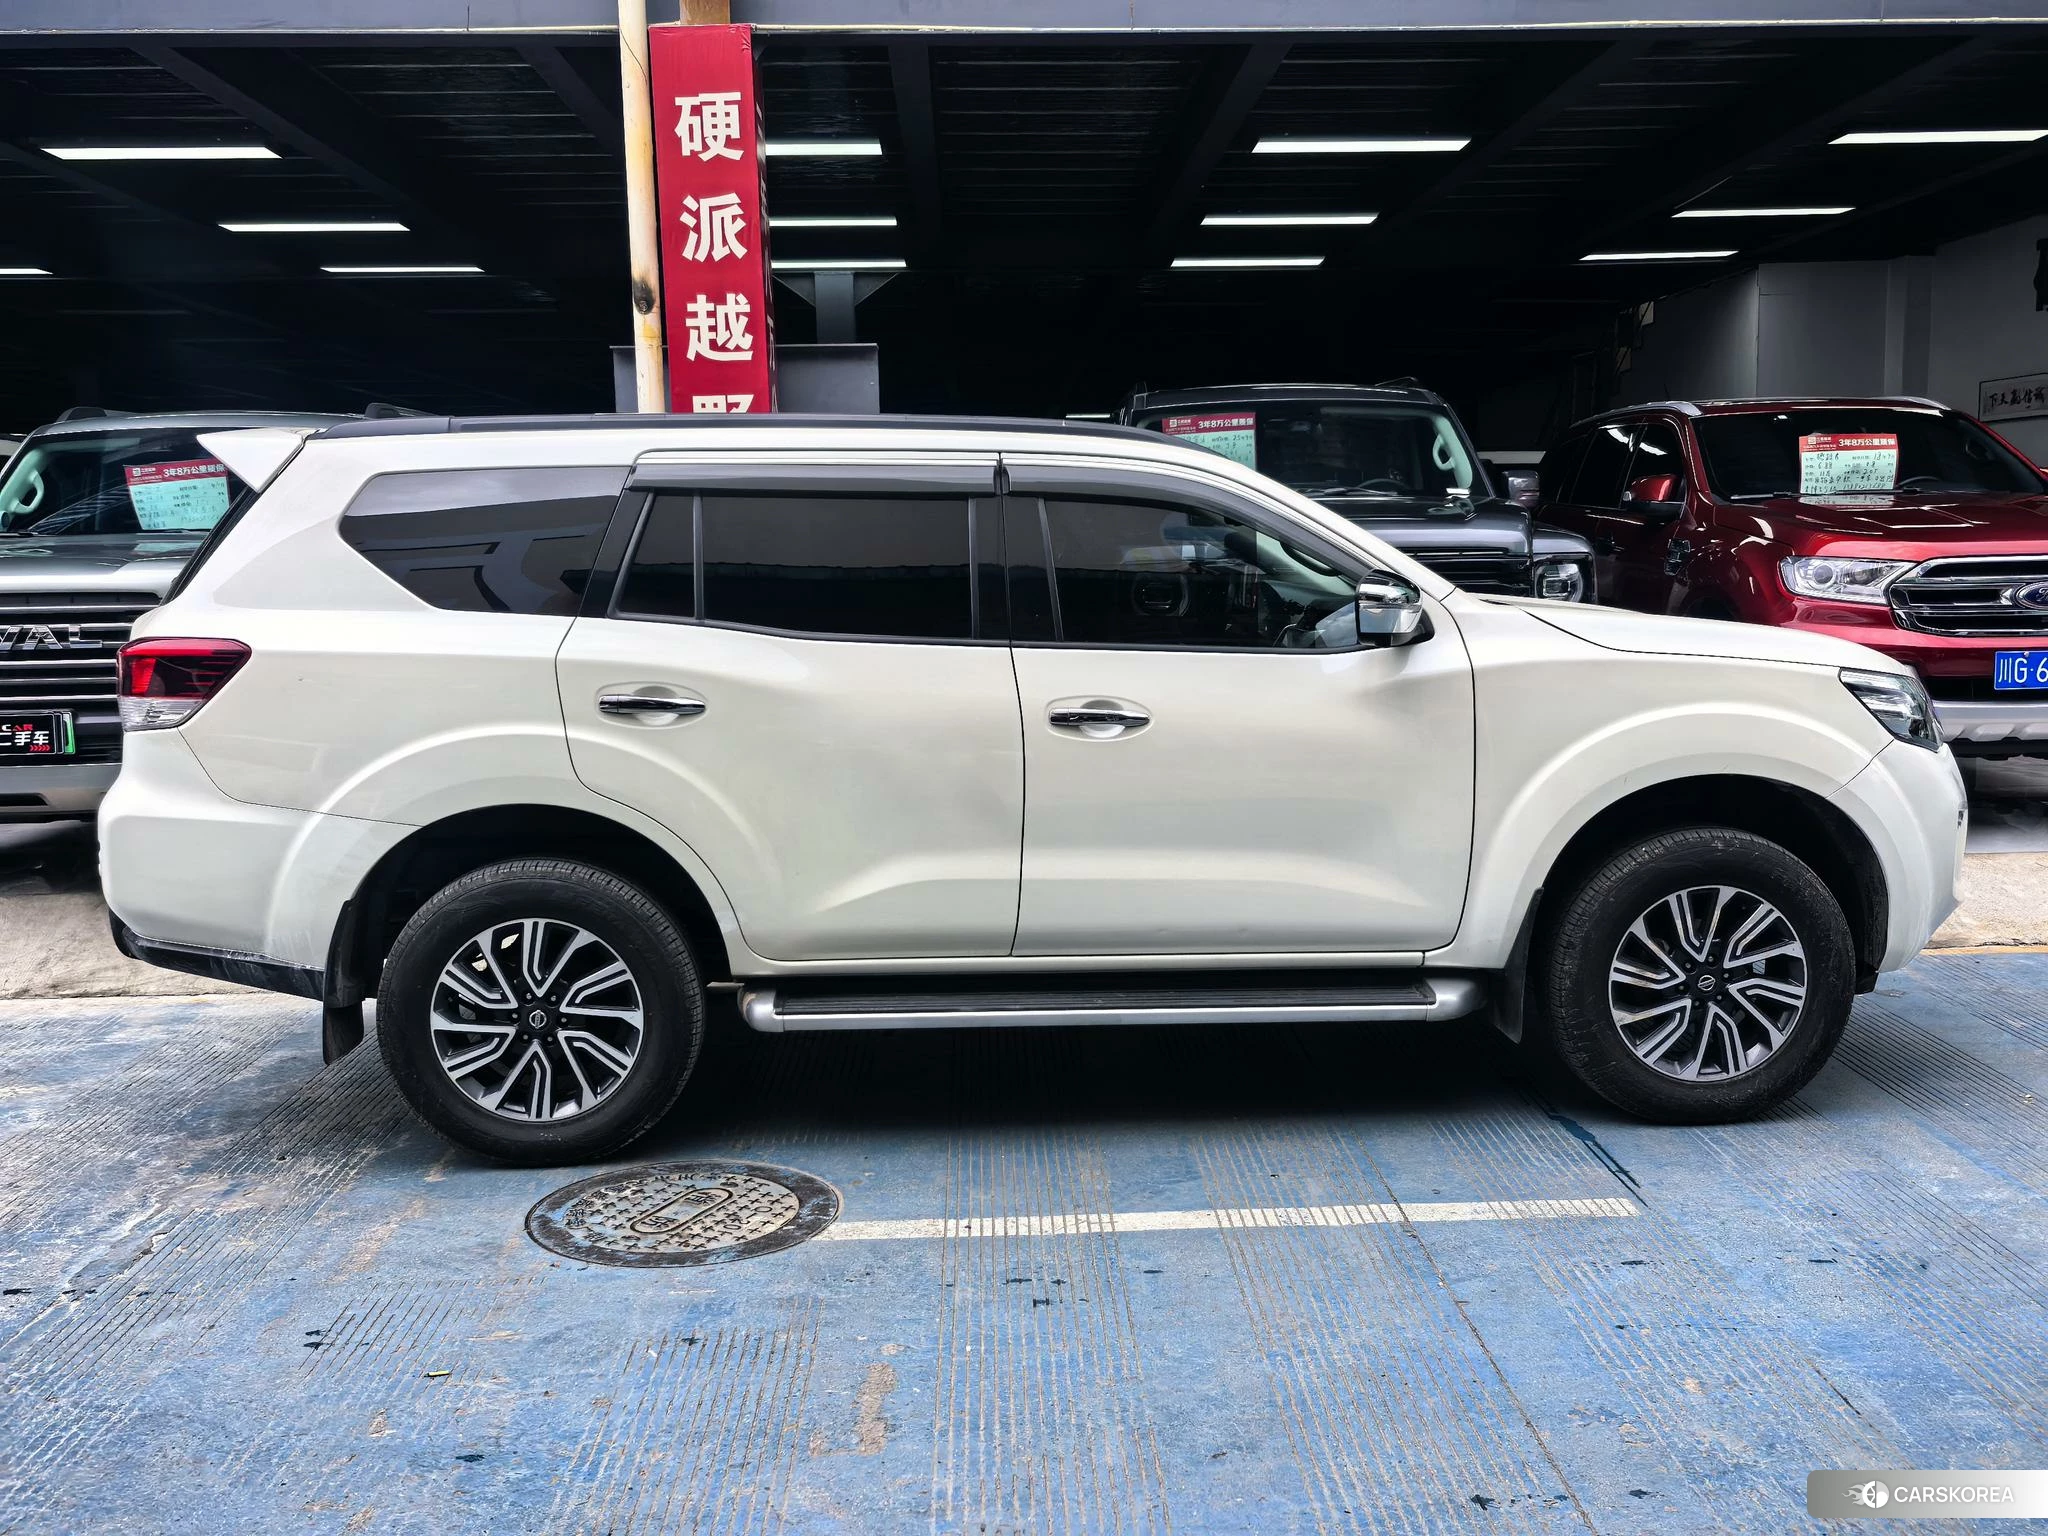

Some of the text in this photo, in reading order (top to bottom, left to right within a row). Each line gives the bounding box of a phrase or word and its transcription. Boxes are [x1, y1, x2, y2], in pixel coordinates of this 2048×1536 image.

[674, 91, 755, 413] 硬派越
[0, 730, 50, 746] 二手车
